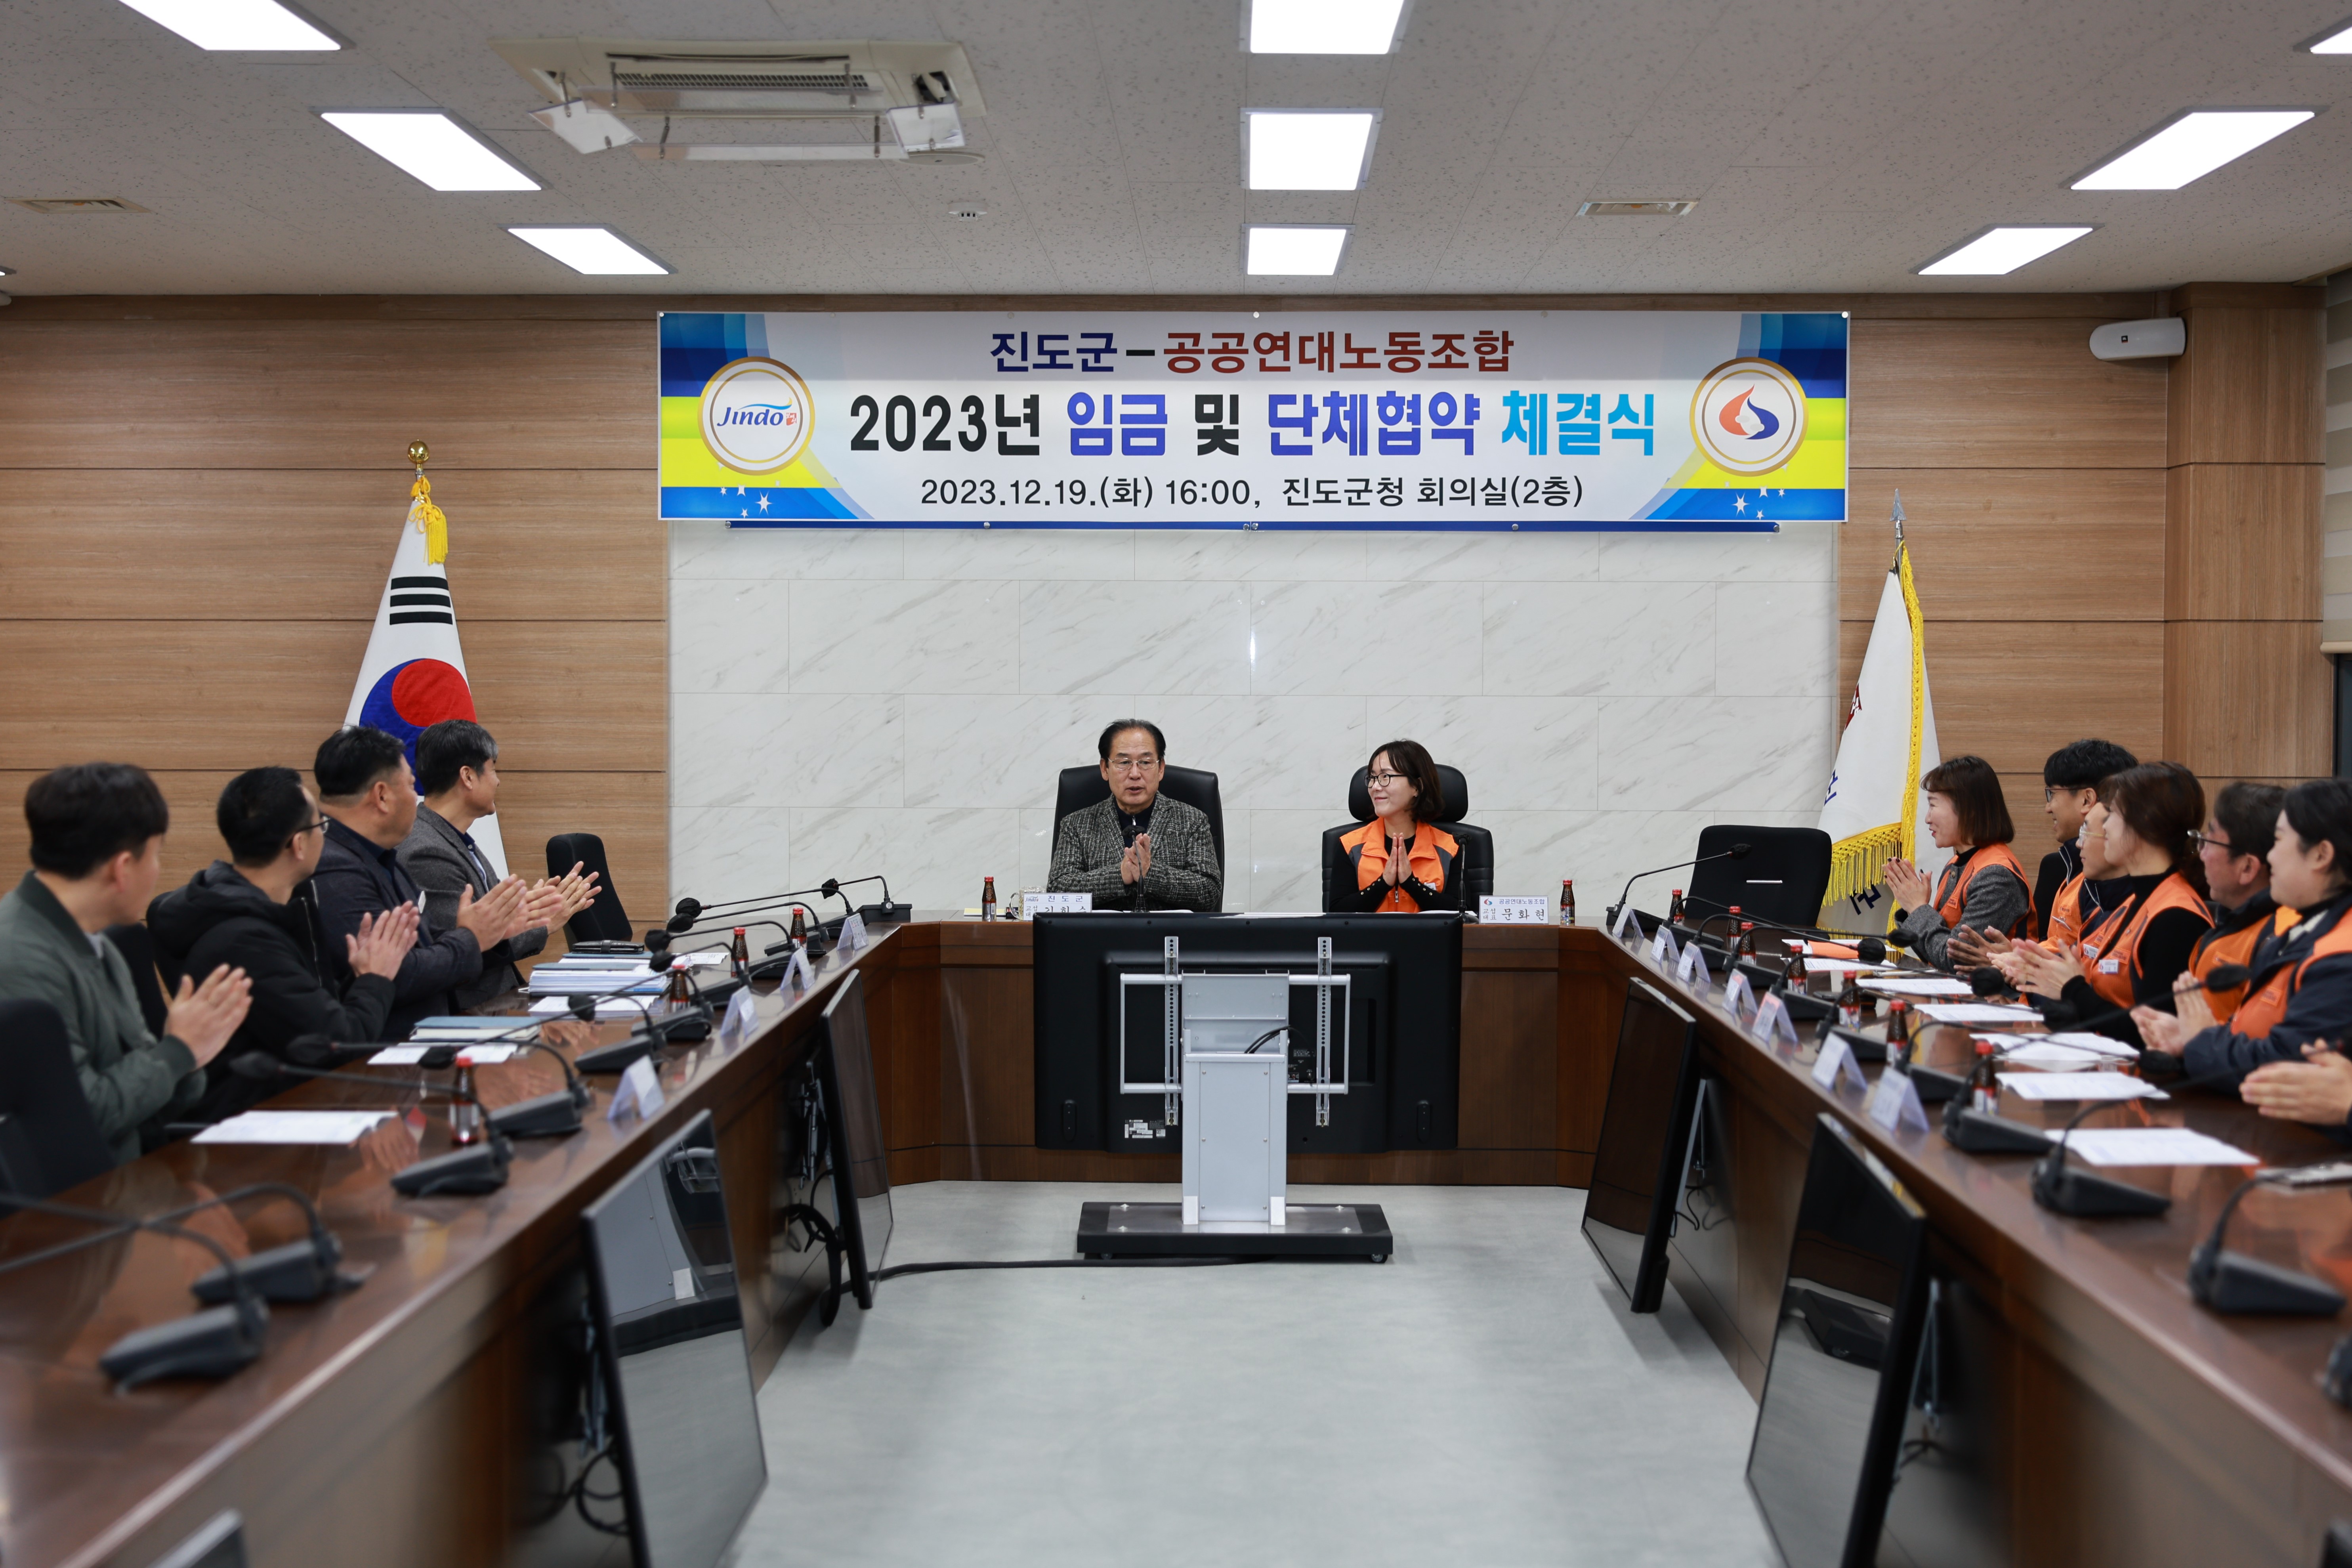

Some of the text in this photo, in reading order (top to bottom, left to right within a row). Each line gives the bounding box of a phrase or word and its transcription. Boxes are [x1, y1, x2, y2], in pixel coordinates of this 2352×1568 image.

[717, 407, 784, 426] Jindo
[850, 390, 1654, 456] 2023년 임금 및 단체협약 체결식
[921, 475, 1582, 508] 2023.12.19.(화) 16:00, 진도군청 회의실(2층)
[1501, 908, 1545, 921] 문화현
